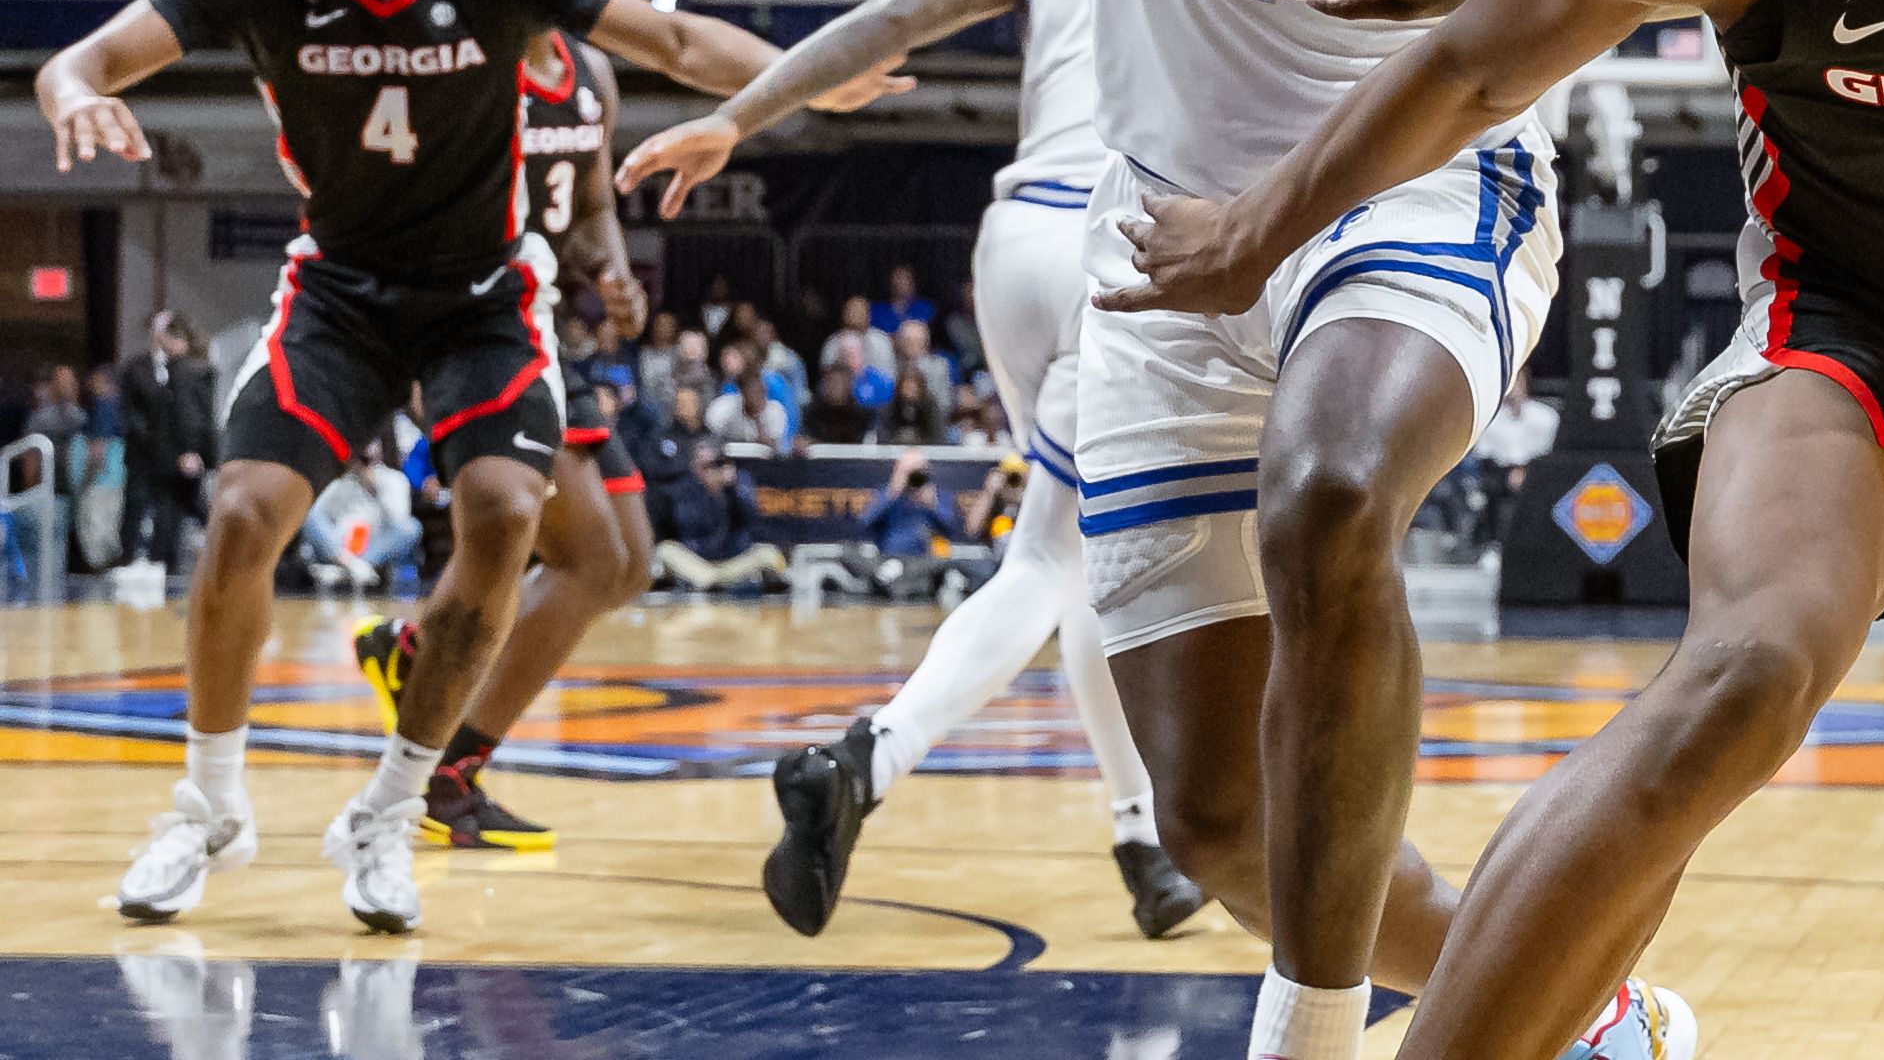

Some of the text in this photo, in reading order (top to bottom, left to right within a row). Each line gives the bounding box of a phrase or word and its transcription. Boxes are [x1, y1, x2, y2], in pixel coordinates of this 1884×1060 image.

[298, 37, 487, 77] GEORGIA
[361, 85, 419, 165] 4
[543, 160, 576, 234] 3
